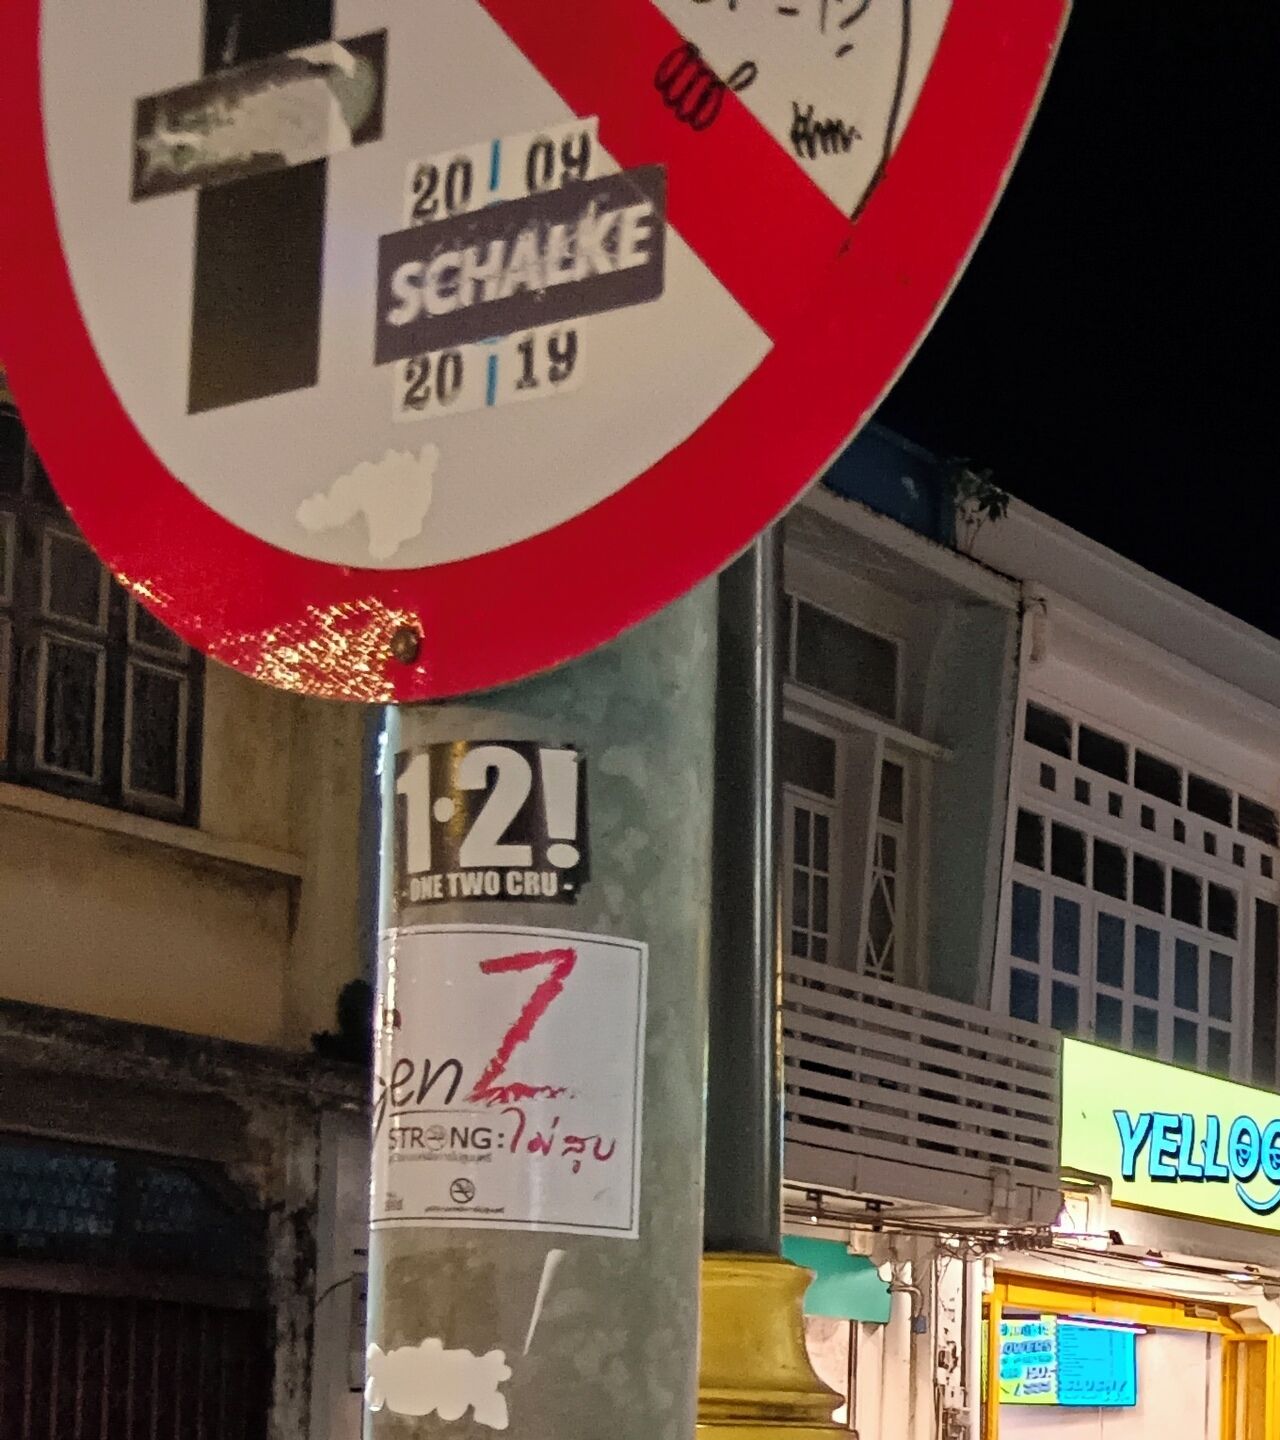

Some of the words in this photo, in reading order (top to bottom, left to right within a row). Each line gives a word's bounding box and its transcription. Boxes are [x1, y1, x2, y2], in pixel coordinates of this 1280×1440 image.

[412, 155, 474, 219] 20
[386, 201, 653, 327] SCHALKE
[402, 351, 464, 411] 20
[514, 330, 579, 391] 19
[410, 874, 444, 902] ONE
[446, 870, 500, 897] TWO
[506, 870, 558, 897] CRU
